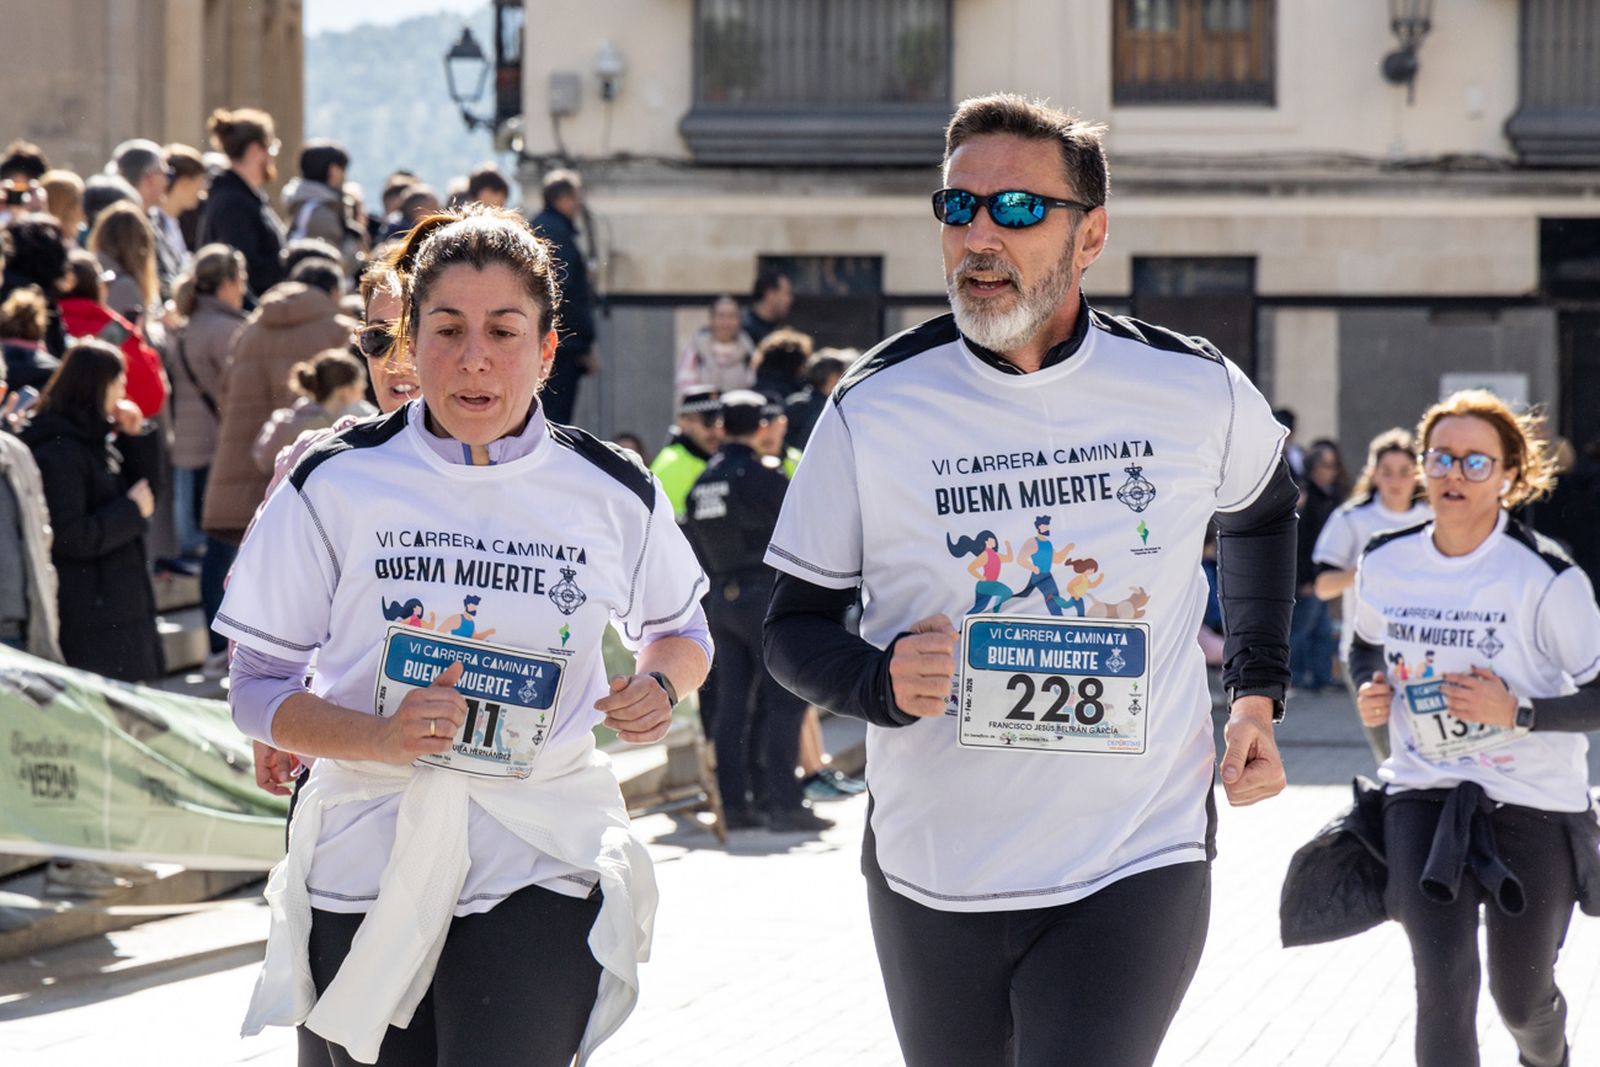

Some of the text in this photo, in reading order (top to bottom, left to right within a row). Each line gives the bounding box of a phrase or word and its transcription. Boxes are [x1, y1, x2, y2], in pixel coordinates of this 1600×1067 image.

[932, 440, 1154, 476] VI CARRERA CAMINATA
[935, 473, 1113, 515] BUENA MUERTE
[376, 530, 587, 565] VI CARRERA CAMINATA
[375, 556, 546, 596] BUENA MUERTE
[1395, 607, 1441, 620] CARRERA
[1445, 610, 1506, 623] CAMINATA
[989, 628, 1128, 646] VI CARRERA CAMINATA
[1419, 626, 1475, 648] MUERTE
[409, 642, 543, 679] VI CARRERA CAMINATA
[987, 646, 1099, 671] BUENA MUERTE
[403, 659, 513, 698] BUEN MUERTE
[1005, 673, 1105, 726] 228
[462, 698, 501, 748] 11
[988, 720, 1119, 735] FRANCISCO JESÚS BELTRÁN GARCÍA
[1432, 714, 1485, 740] 13
[469, 747, 512, 760] HERNÁNDEZ
